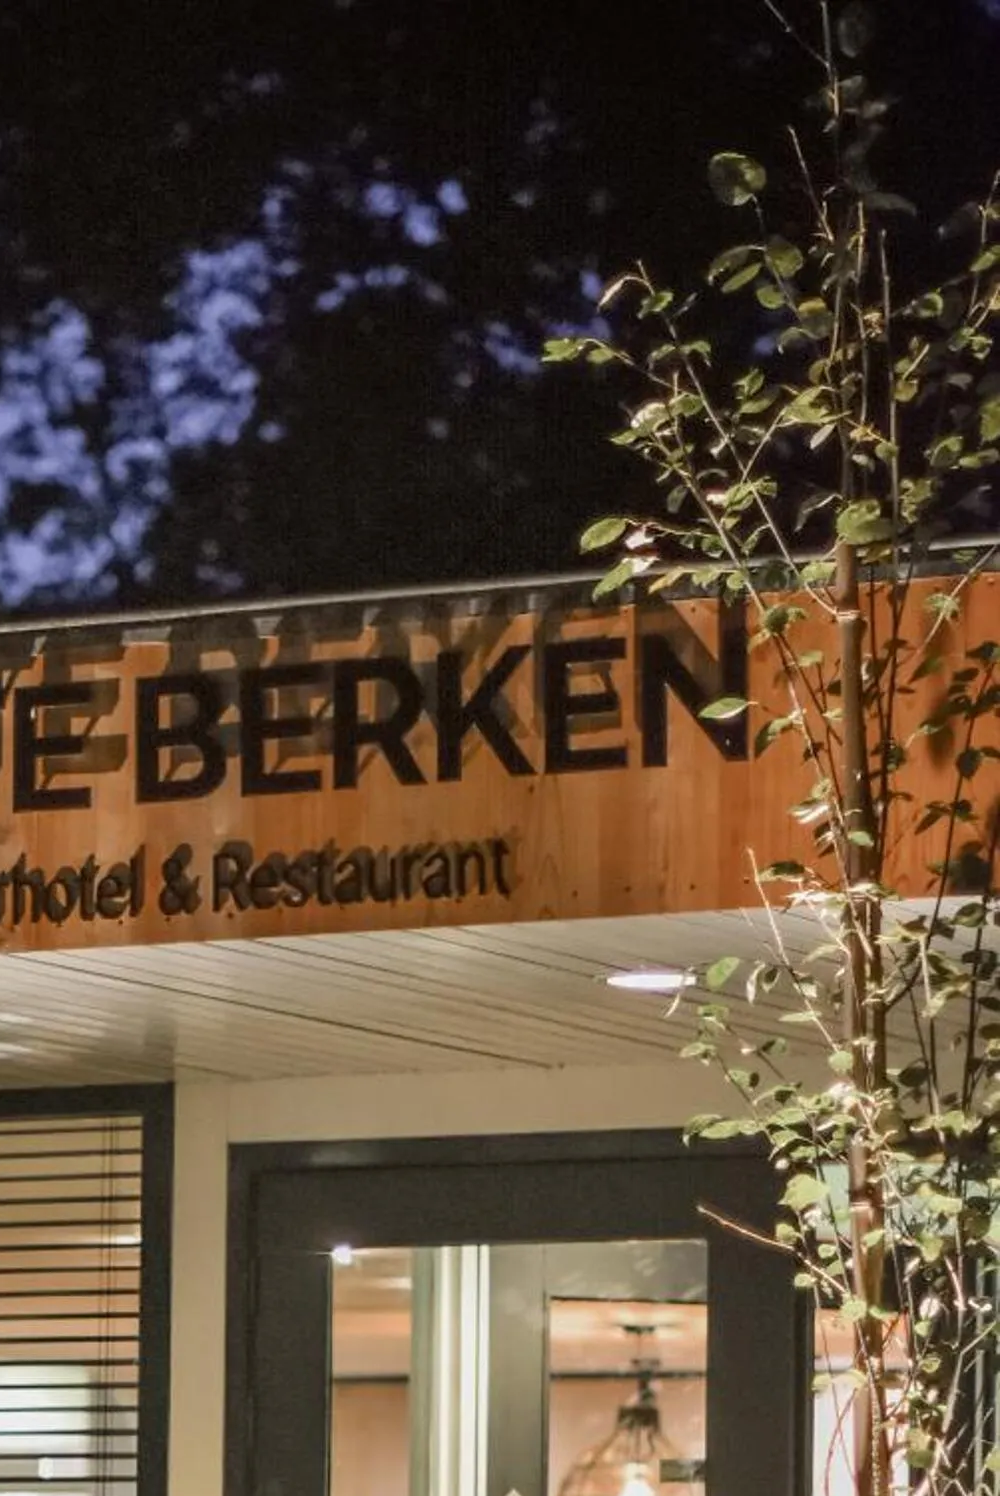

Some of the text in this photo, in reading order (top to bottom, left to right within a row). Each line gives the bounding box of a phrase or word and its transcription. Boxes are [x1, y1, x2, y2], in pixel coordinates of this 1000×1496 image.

[135, 626, 749, 804] BERKEN
[159, 846, 201, 915] &
[213, 838, 510, 912] Restaurant
